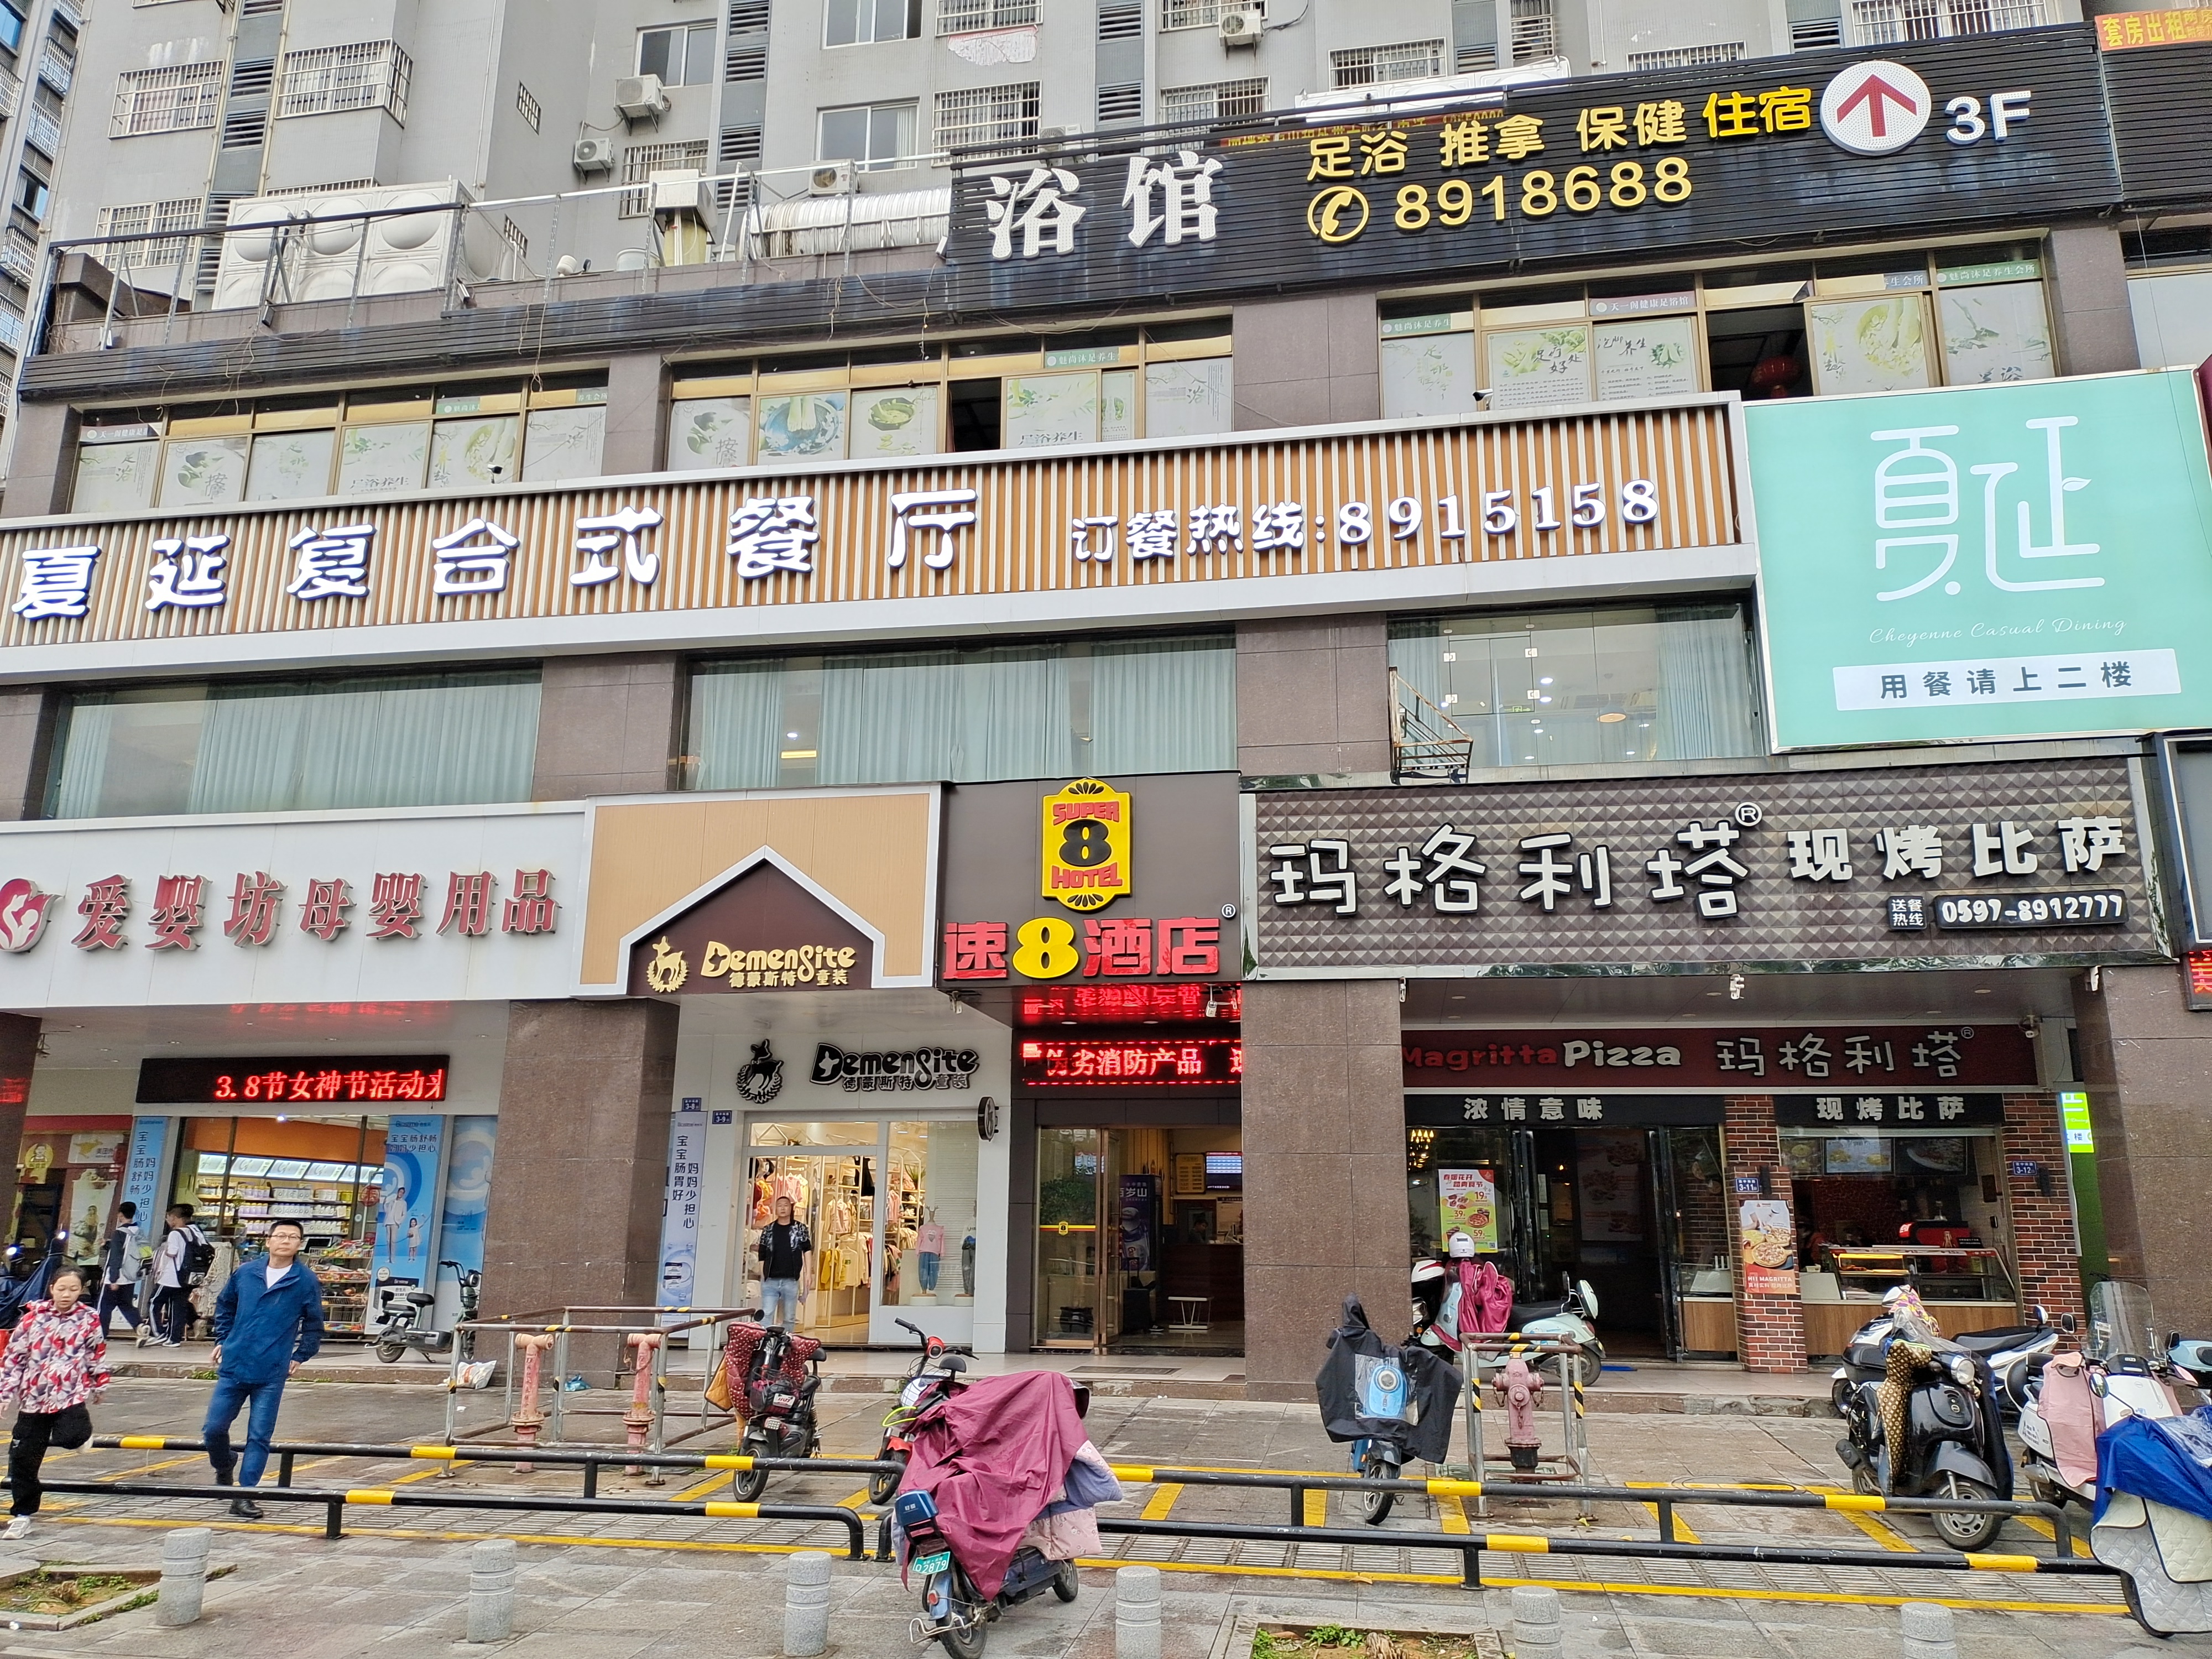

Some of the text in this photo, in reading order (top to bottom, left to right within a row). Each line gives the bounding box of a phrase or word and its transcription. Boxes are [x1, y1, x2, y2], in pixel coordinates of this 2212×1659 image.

[2103, 11, 2187, 46] 套房出租
[1307, 132, 1407, 181] 足浴
[1440, 114, 1546, 168] 推拿
[1576, 100, 1687, 152] 保健
[1703, 87, 1813, 138] 住宿
[1944, 90, 2032, 145] 3F
[986, 151, 1224, 260] 浴馆
[1395, 157, 1692, 230] 8918688
[1948, 264, 2036, 281] 魅尚沐足养生会所
[1058, 351, 1120, 366] 魅尚沐足养生
[12, 488, 979, 620] 夏延复合式餐厅
[1870, 617, 2127, 648] Cheyenne Casual Dining
[1881, 661, 2132, 700] 用餐请上二楼
[1052, 801, 1120, 826] SUPER
[1059, 819, 1112, 867] 8
[1051, 862, 1123, 889] HOTEL
[1269, 816, 2126, 919] 玛格利塔 现烤比萨
[70, 868, 561, 951] 爱婴坊母婴用品
[1891, 899, 1923, 912] 送餐
[1892, 912, 1924, 927] 热线
[1942, 894, 2124, 923] 0597-8912777
[943, 917, 1221, 980] 速8酒店
[816, 969, 849, 986] 童装
[1563, 1040, 1682, 1068] Pizza
[1717, 1030, 1961, 1077] 玛格利塔
[936, 1073, 971, 1090] 童装
[1463, 1097, 1603, 1121] 浓情意味
[1817, 1096, 1965, 1121] 现烤比萨
[391, 1134, 437, 1142] 宝宝肠舒畅
[672, 1135, 688, 1201] 宝宝肠胃好
[138, 1157, 155, 1222] 妈妈少担心
[684, 1162, 699, 1229] 妈妈少担心
